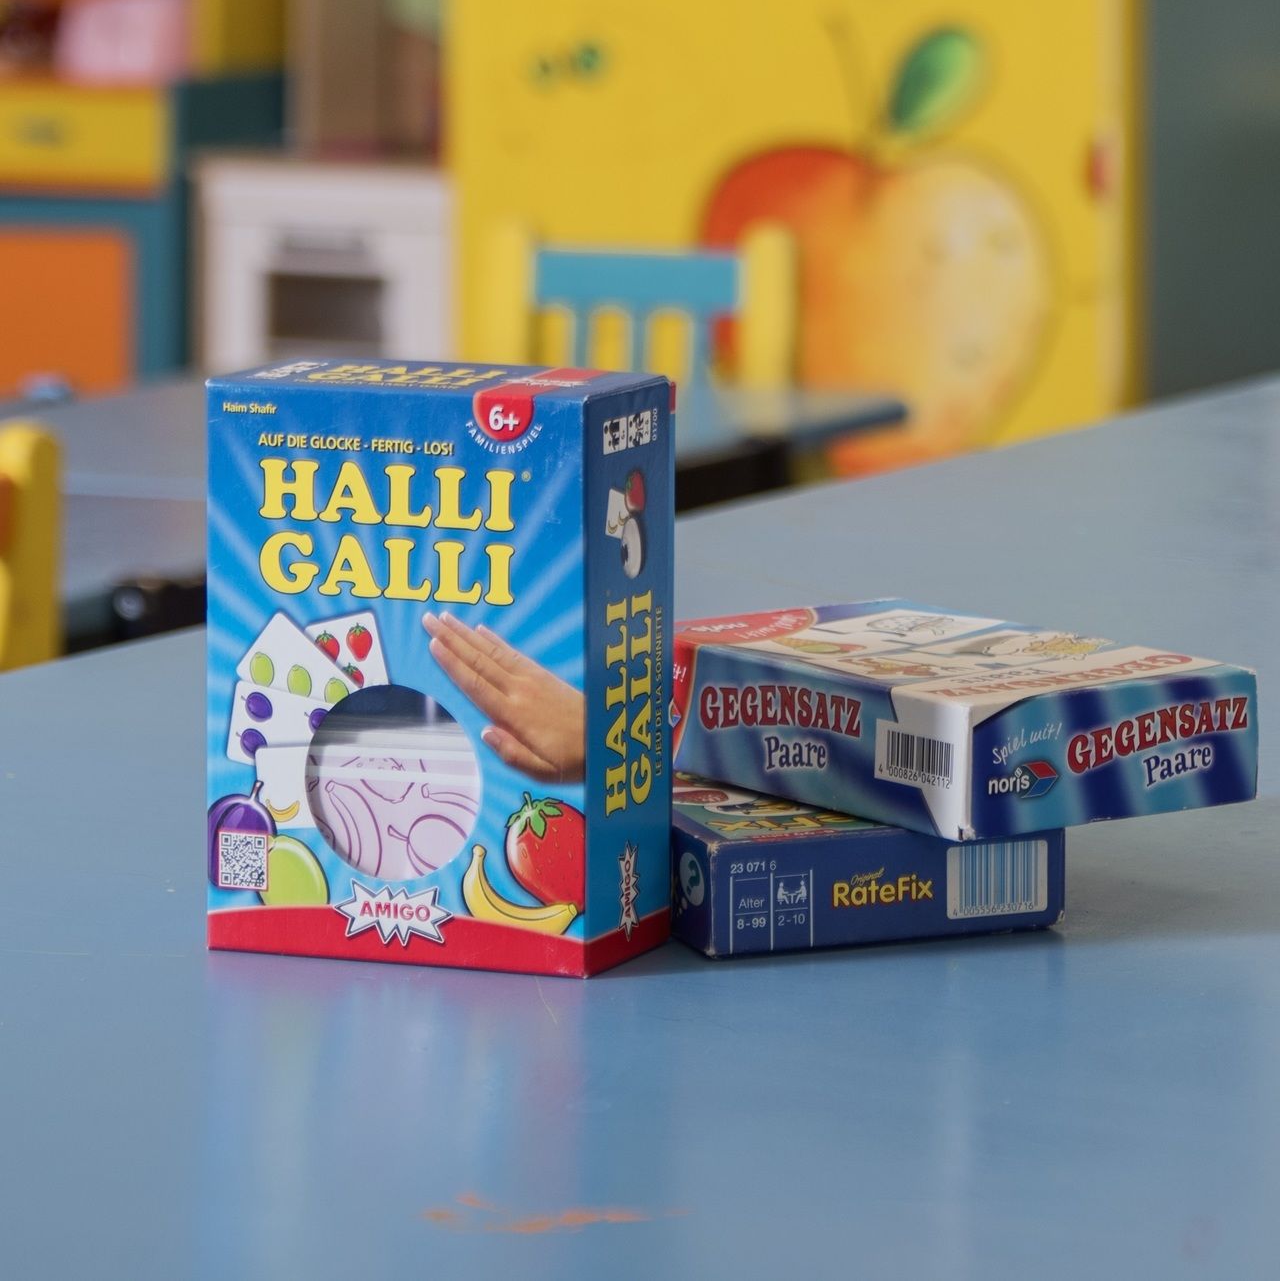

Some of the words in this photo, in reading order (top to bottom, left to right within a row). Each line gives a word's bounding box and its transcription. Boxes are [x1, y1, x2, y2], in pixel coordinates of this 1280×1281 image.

[223, 402, 246, 413] Haim
[249, 403, 277, 415] Shafir
[488, 405, 519, 431] 6+
[258, 433, 284, 447] AUF
[287, 434, 306, 448] DIE
[310, 436, 360, 451] GLOCKE
[371, 439, 413, 454] FERTIG
[424, 442, 454, 456] LOS!
[465, 421, 543, 455] FAMILIENSPIEL
[258, 458, 516, 532] HALLI
[258, 530, 517, 606] GALLI
[604, 597, 628, 819] HALLI
[629, 588, 653, 805] GALLI
[655, 685, 662, 704] LA
[655, 708, 662, 727] DE
[700, 685, 862, 738] GEGENSATZ
[991, 730, 1029, 767] Spiel
[1029, 721, 1062, 745] mit!
[1066, 696, 1249, 774] GEGENSATZ
[655, 760, 662, 776] LE
[764, 736, 826, 770] Paare
[1142, 745, 1213, 787] Paare
[888, 767, 918, 782] 000826
[921, 772, 951, 789] 042112
[988, 774, 1030, 796] noris
[730, 862, 744, 874] 23
[746, 861, 766, 872] 071
[769, 860, 777, 871] 6
[738, 897, 765, 910] Alter
[832, 873, 934, 908] RateFix
[359, 900, 431, 922] AMIGO
